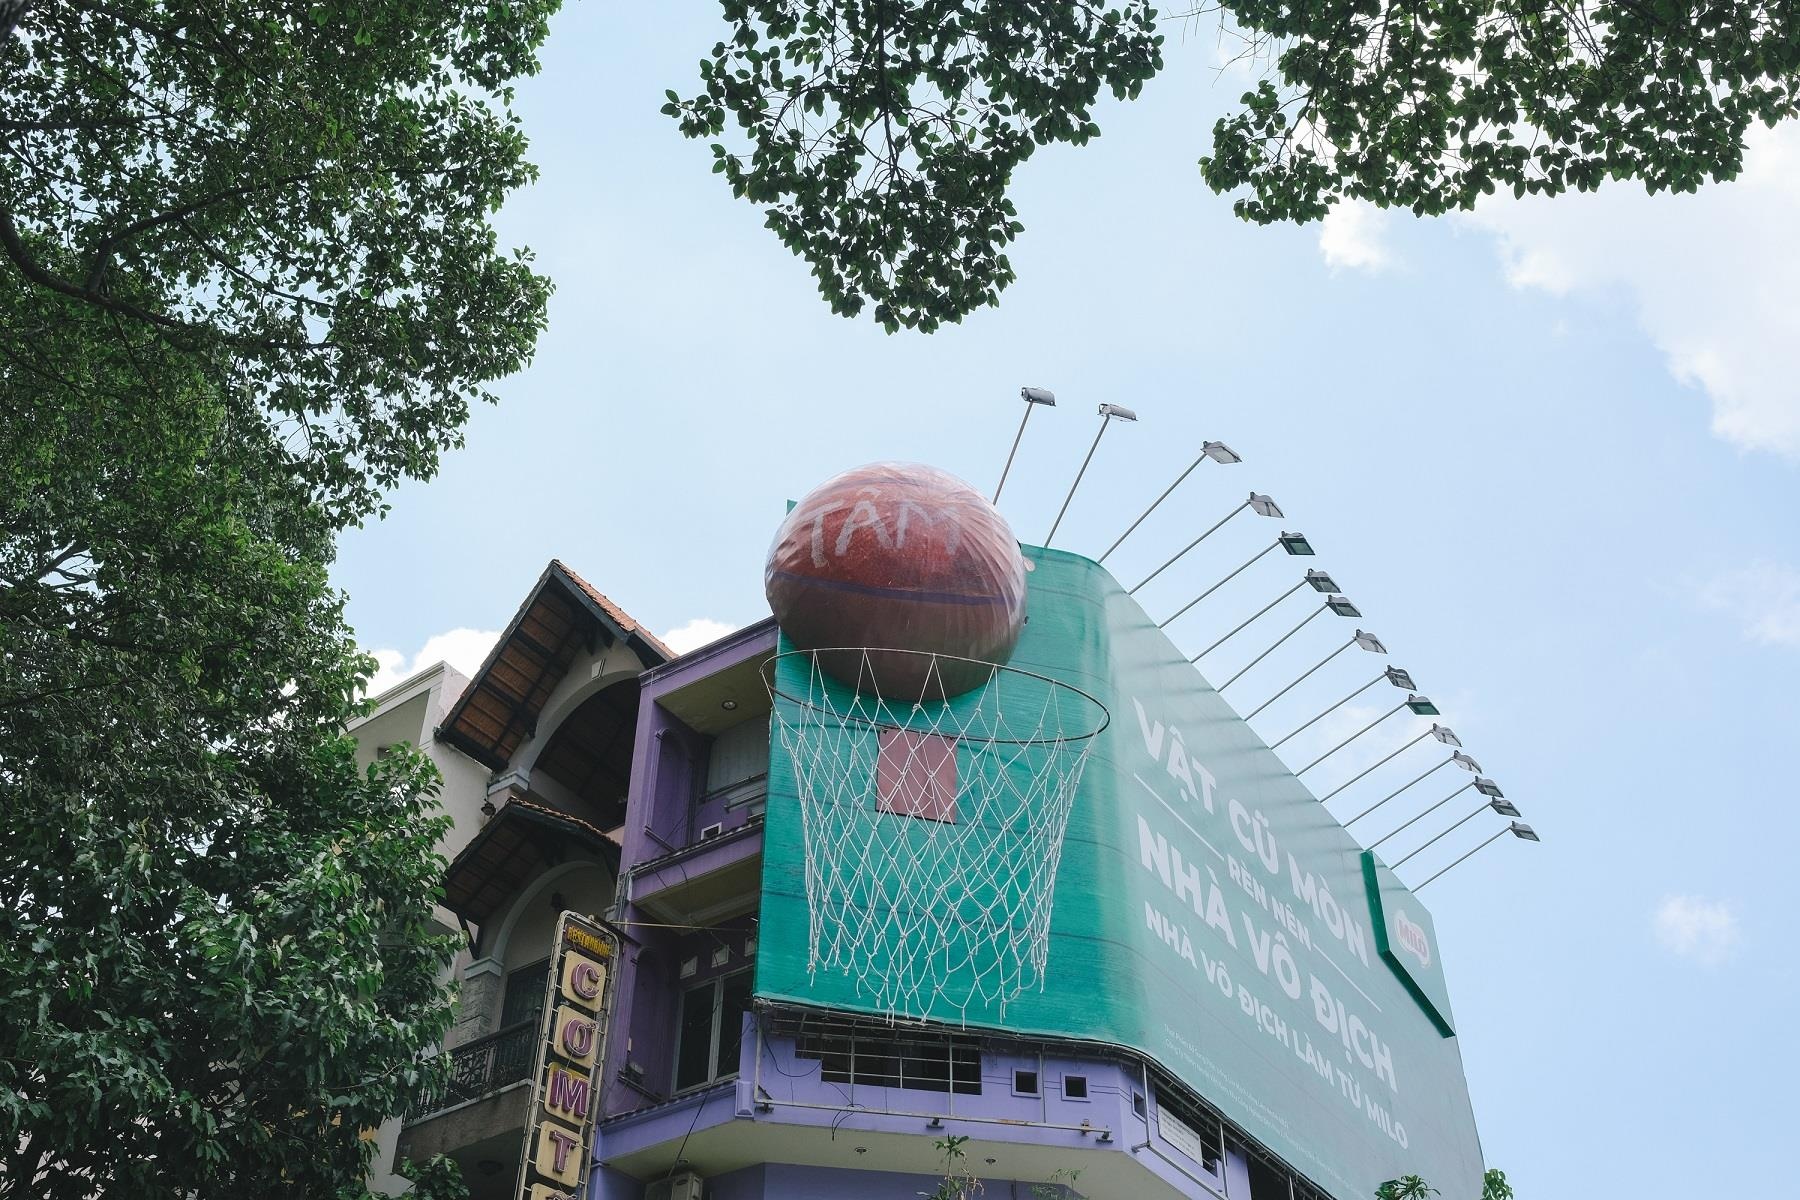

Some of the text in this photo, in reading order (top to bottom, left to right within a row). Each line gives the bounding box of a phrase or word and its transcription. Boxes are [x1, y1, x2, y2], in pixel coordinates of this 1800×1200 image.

[1132, 696, 1370, 969] VẬT CŨ MÒN
[1137, 813, 1238, 950] NHÀ
[1241, 911, 1301, 1000] VÔ
[1309, 972, 1399, 1094] ĐỊCH
[1227, 853, 1312, 951] RÈN NÊN
[1144, 900, 1199, 970] NHÀ
[1200, 949, 1233, 998] VÔ
[1238, 983, 1290, 1049] ĐỊCH
[1292, 1031, 1335, 1088] LÀM
[1336, 1068, 1362, 1110] TỪ
[1365, 1093, 1409, 1150] MILO
